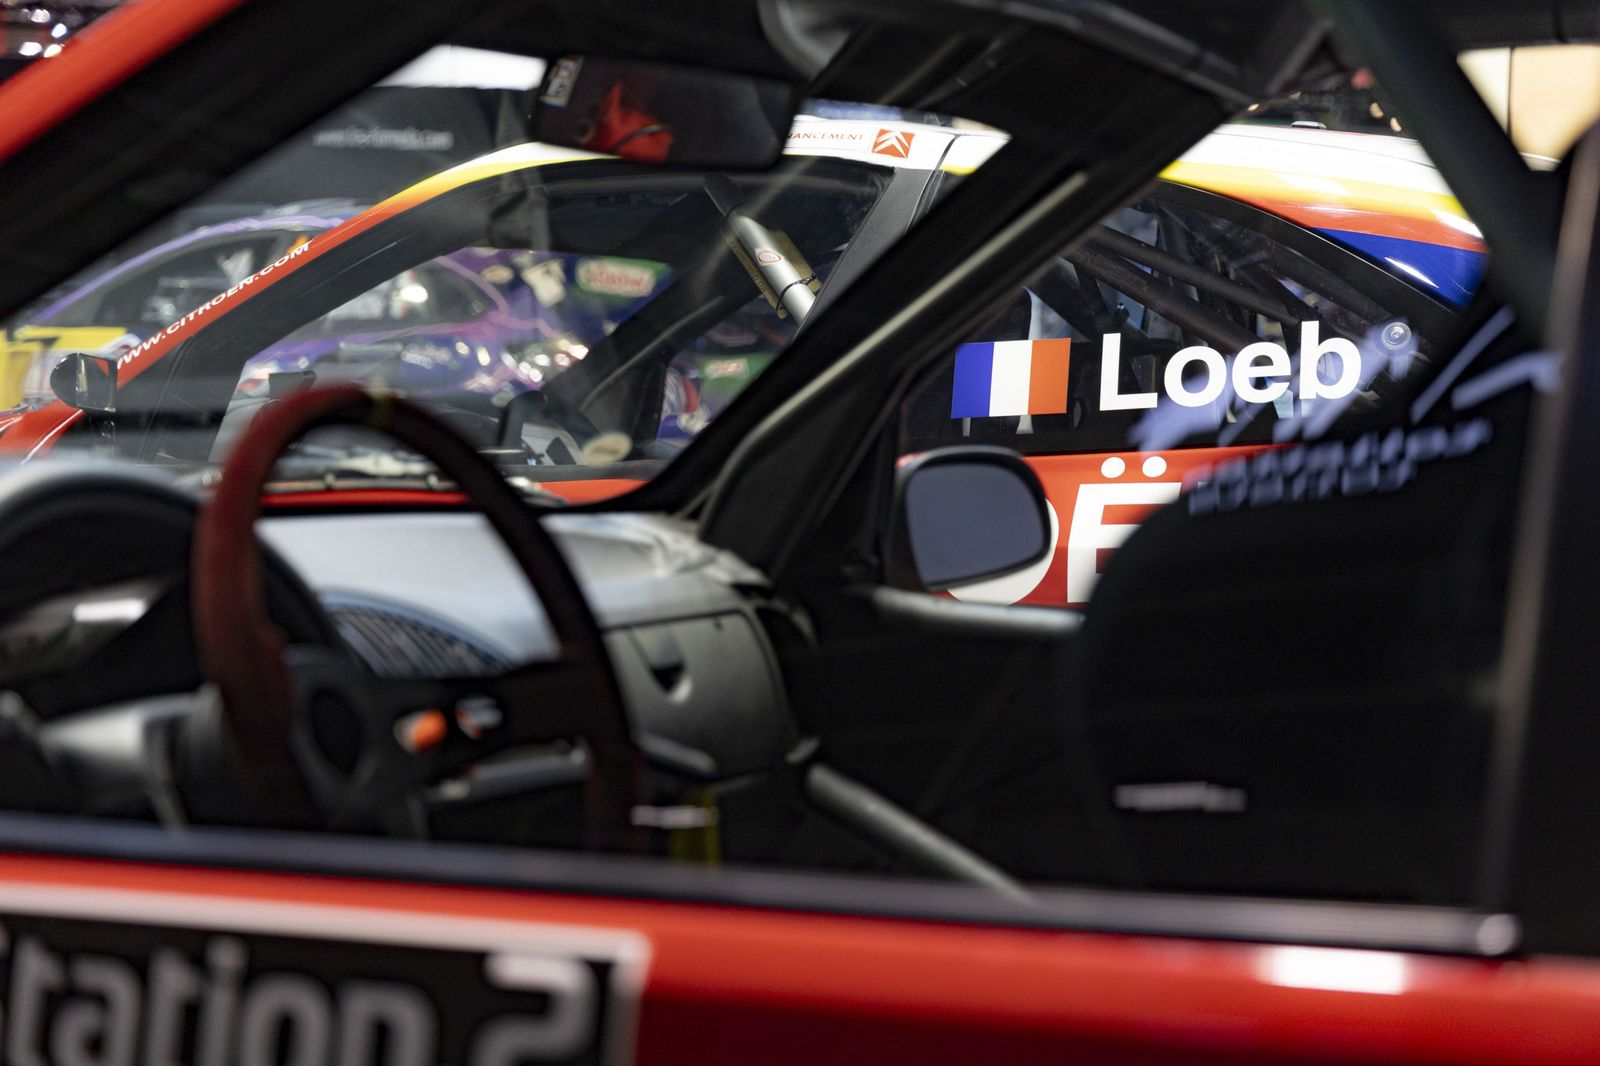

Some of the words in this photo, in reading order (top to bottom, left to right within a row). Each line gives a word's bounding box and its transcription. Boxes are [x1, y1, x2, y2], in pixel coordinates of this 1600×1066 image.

[1099, 320, 1362, 411] Loeb
[0, 930, 440, 1066] tation
[472, 948, 598, 1066] 2
